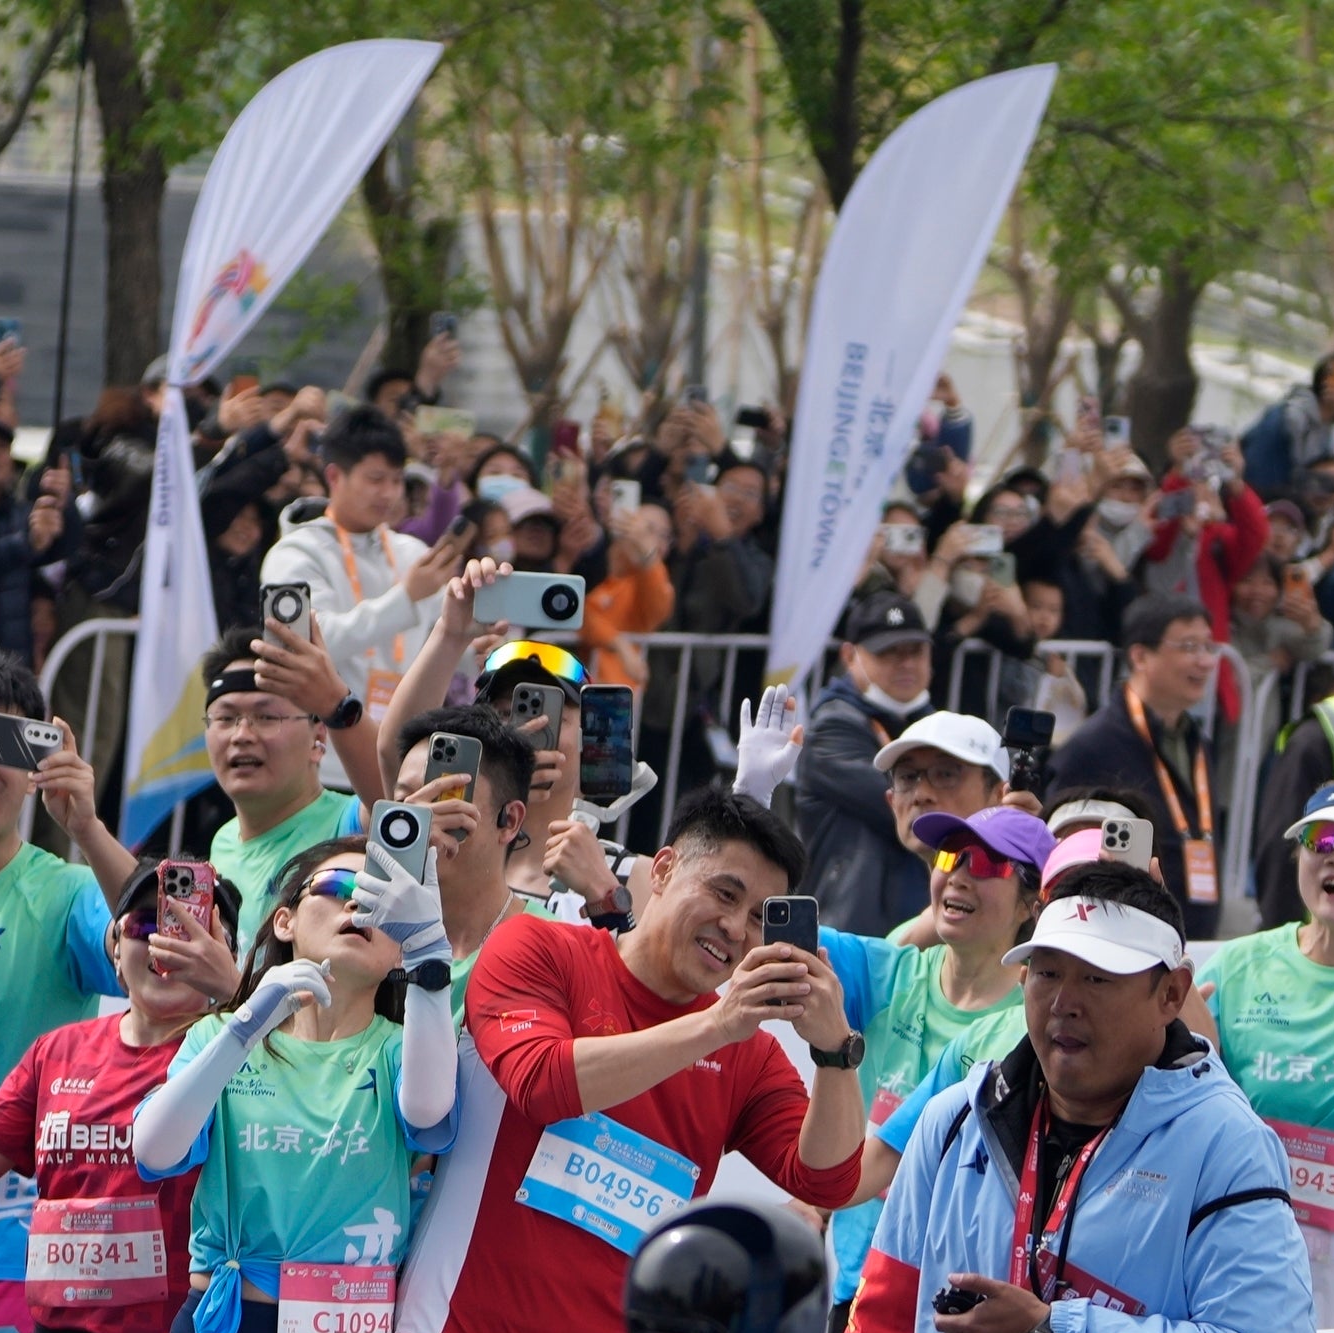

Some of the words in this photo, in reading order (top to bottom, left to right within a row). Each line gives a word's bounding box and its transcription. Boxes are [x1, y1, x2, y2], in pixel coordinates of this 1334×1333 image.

[511, 1020, 533, 1033] CHN
[37, 1110, 71, 1150] 北京
[70, 1123, 134, 1151] BEIJ
[37, 1153, 74, 1165] HALF
[85, 1153, 138, 1165] MARAT
[564, 1152, 664, 1217] B04956
[46, 1241, 139, 1265] B07341
